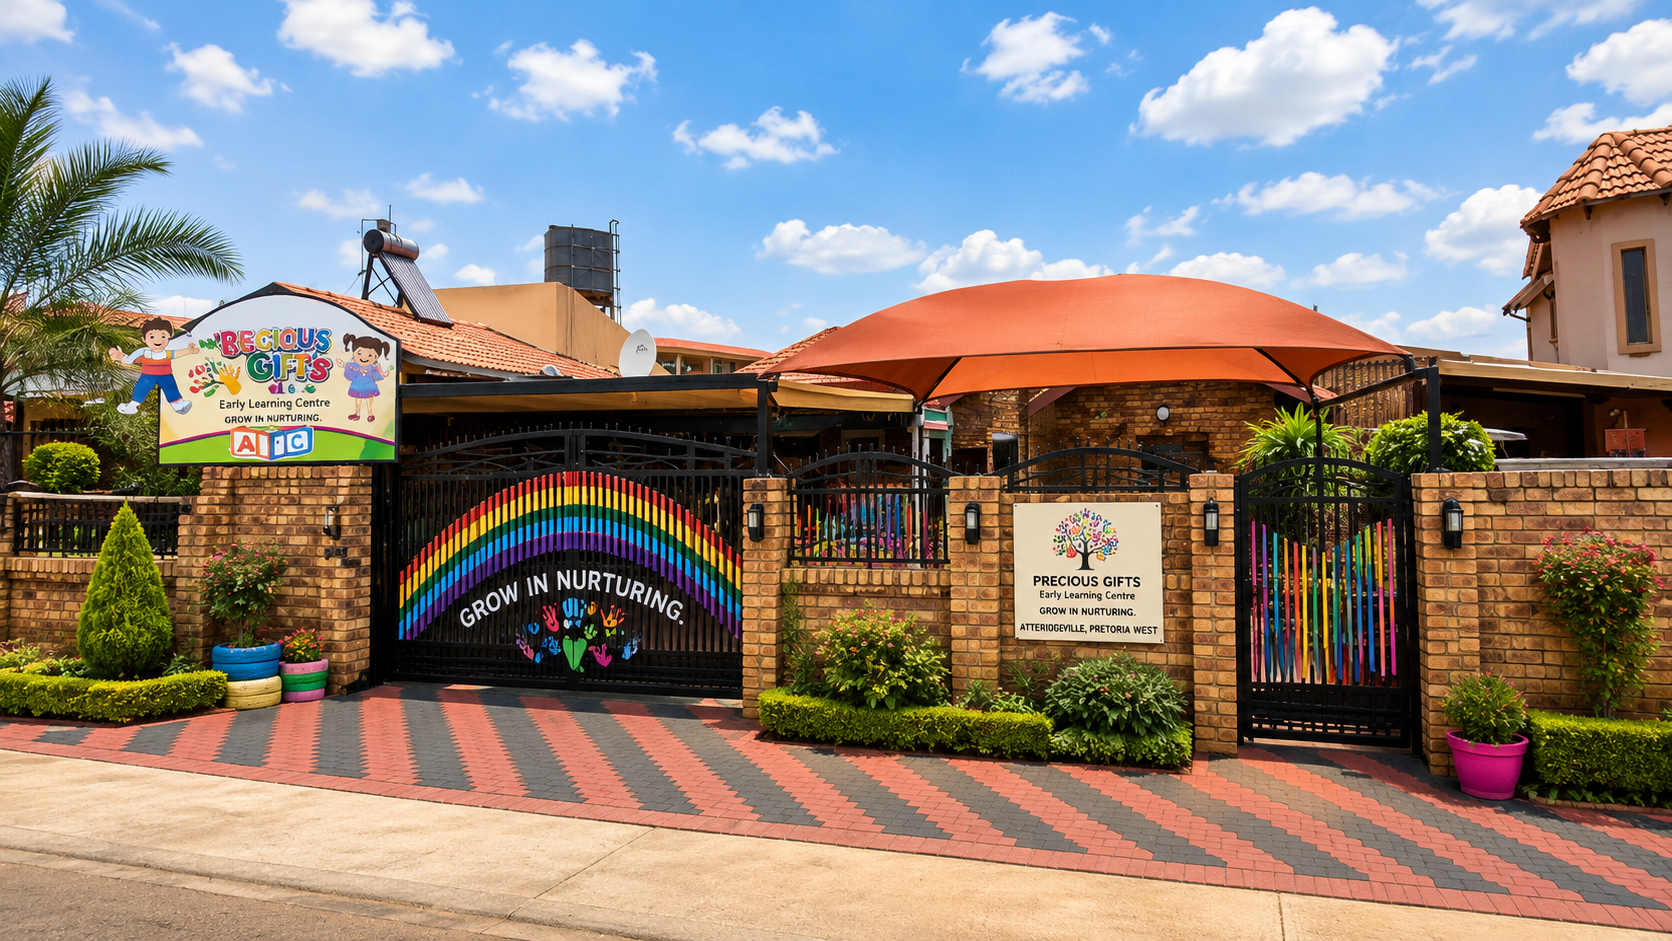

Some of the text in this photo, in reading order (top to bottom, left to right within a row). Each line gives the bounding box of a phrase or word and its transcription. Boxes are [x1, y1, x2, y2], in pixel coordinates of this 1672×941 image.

[246, 352, 332, 382] GIFTS
[219, 398, 331, 411] Early Learning Centre
[224, 413, 323, 424] GROW IN NURTURING.
[1033, 576, 1141, 588] PRECIOUS GIFTS
[459, 569, 684, 628] GROW IN NURTURING.
[1039, 590, 1062, 601] Early
[1105, 591, 1136, 600] Centre
[1039, 607, 1137, 617] GROW IN NURTURING.
[1089, 624, 1131, 634] PRETORIA
[1133, 626, 1159, 635] WEST
